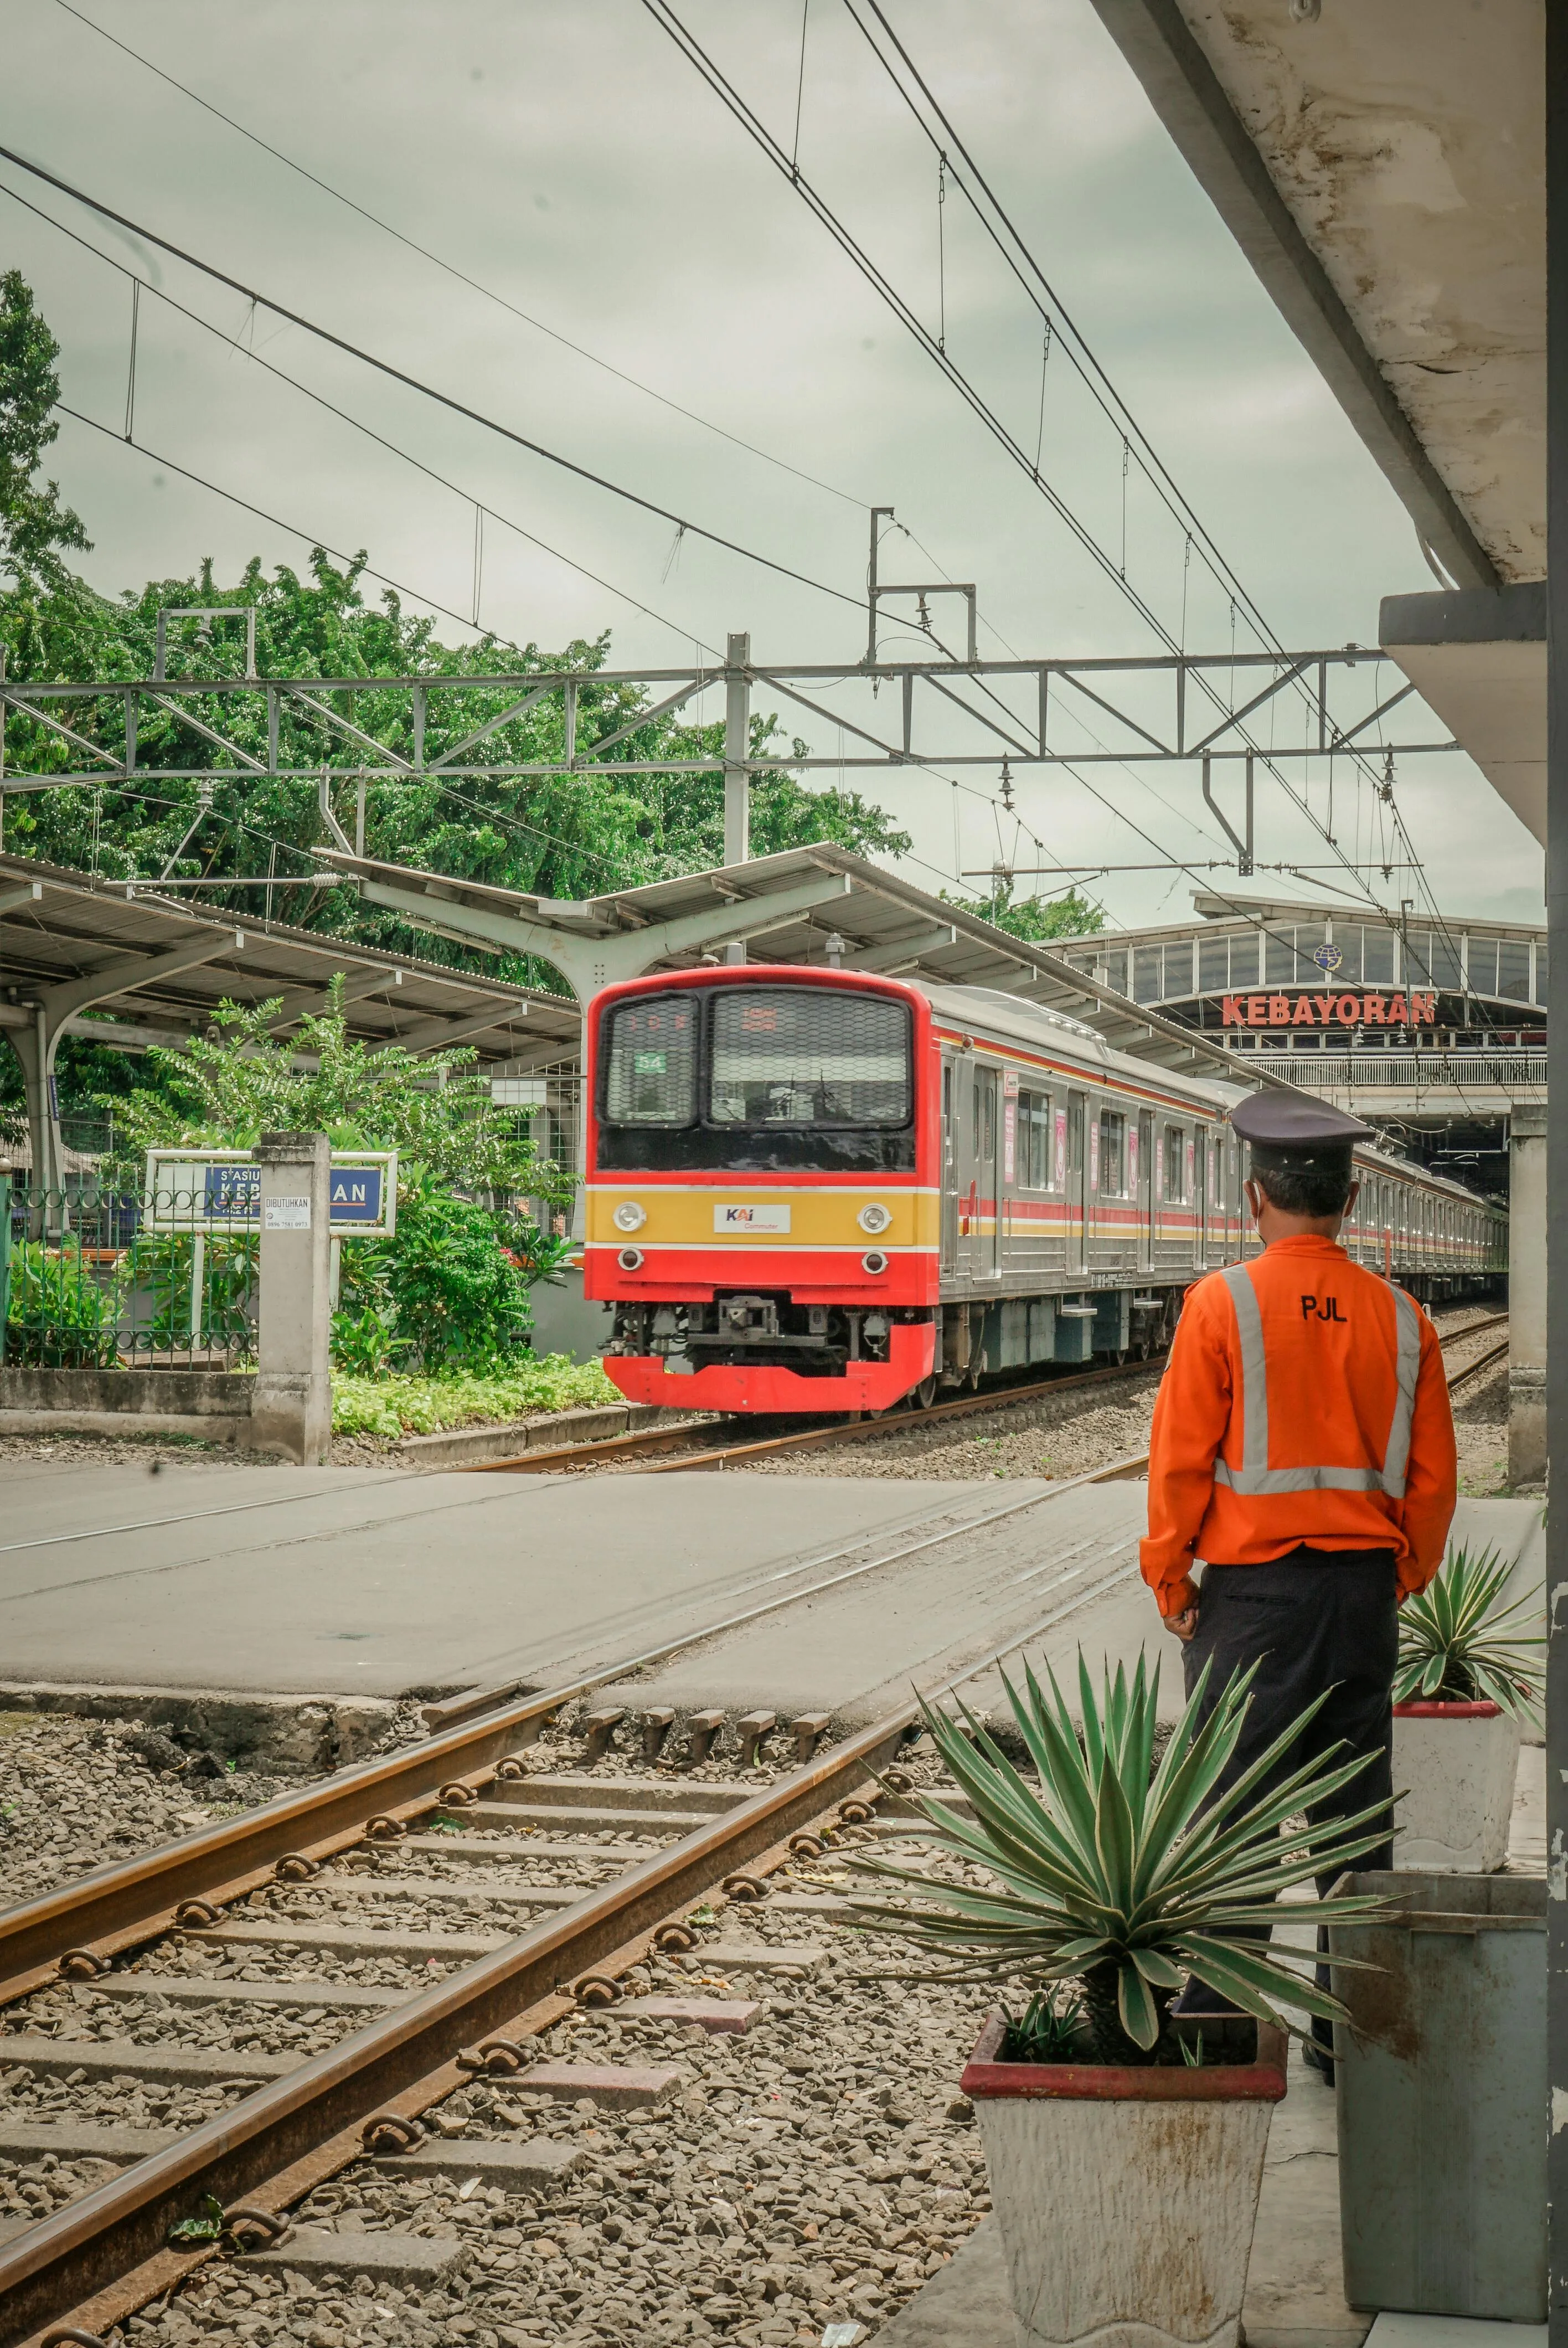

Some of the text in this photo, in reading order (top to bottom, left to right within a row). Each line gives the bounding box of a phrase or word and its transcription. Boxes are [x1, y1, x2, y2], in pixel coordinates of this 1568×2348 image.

[1223, 993, 1435, 1026] KEBAYORAN
[639, 1055, 662, 1069] 54
[221, 1170, 260, 1181] STASIU
[266, 1198, 308, 1208] DIBUTUHKAN
[1301, 1295, 1348, 1322] PJL
